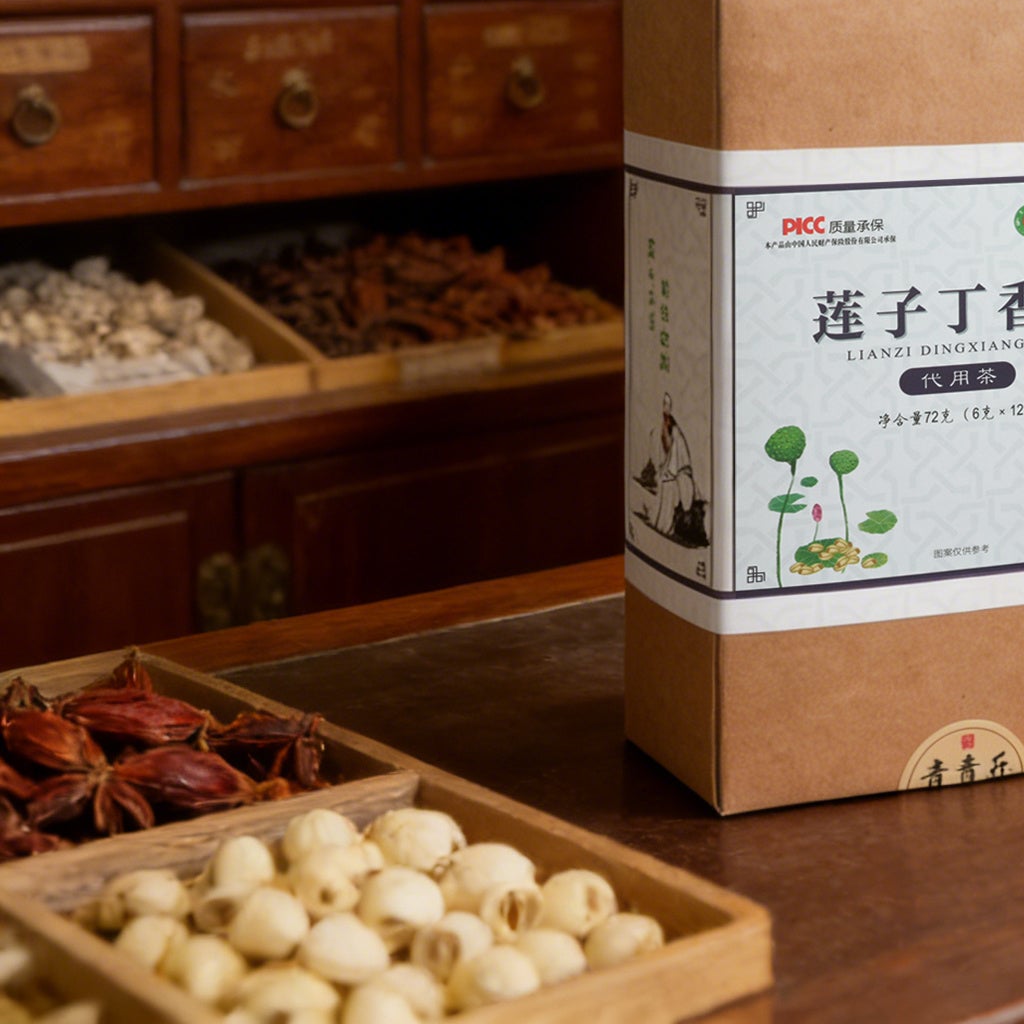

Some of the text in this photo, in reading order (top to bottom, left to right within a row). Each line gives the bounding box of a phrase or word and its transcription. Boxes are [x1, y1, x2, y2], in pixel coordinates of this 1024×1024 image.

[782, 216, 885, 236] PICC 质量承保
[847, 346, 912, 361] LIANZI
[921, 367, 997, 389] 代用茶
[933, 544, 989, 559] 图案仅供参考
